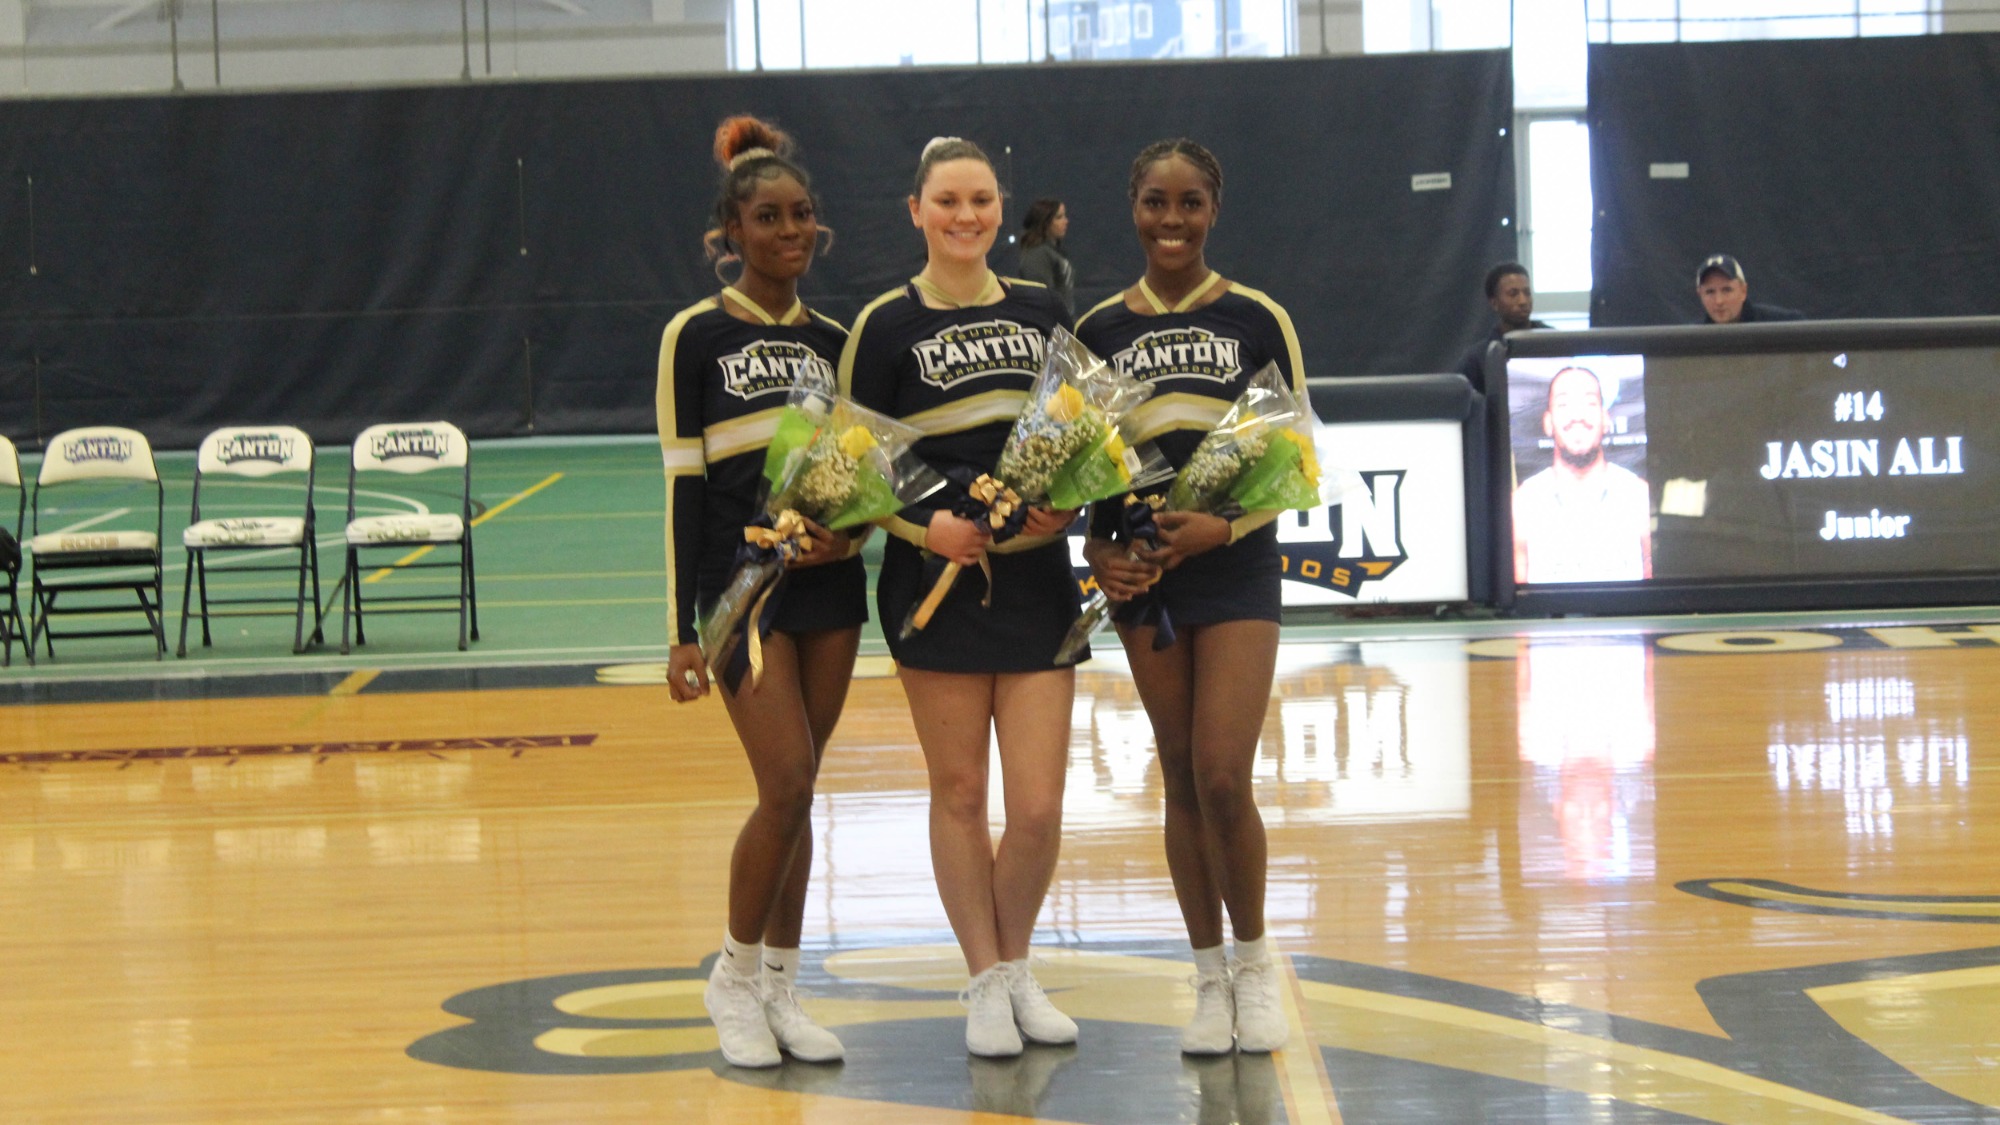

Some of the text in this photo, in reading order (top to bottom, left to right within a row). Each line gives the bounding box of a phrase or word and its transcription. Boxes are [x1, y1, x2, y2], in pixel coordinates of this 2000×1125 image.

[919, 333, 1044, 375] CANTON
[1118, 342, 1235, 378] CANTON
[1138, 365, 1221, 381] ANGAROOS
[1834, 391, 1884, 422] #14
[64, 440, 132, 461] CANTON
[217, 439, 294, 461] CANTON
[370, 434, 449, 457] CANTON
[1760, 436, 1965, 480] JASIN ALI
[1819, 508, 1910, 541] Junior
